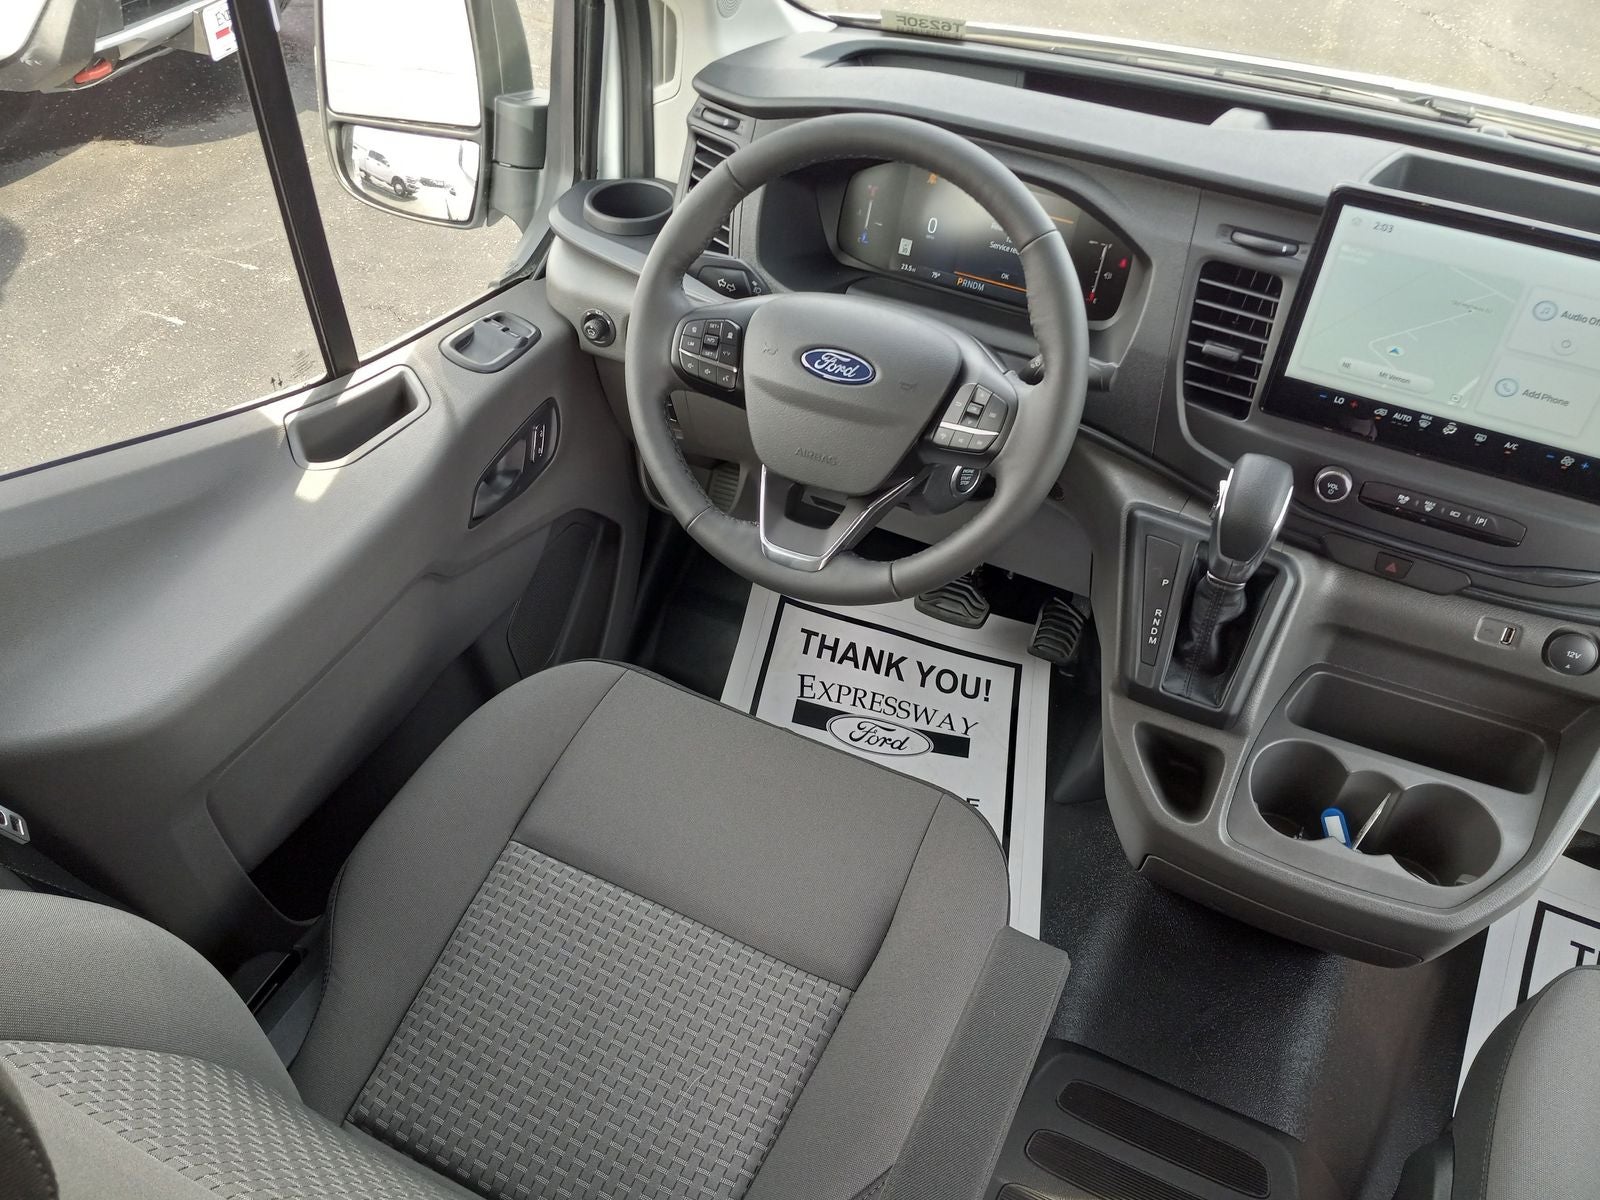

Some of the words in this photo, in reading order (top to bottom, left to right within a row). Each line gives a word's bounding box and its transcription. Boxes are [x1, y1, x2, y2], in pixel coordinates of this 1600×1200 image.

[927, 217, 938, 233] 0
[990, 240, 1010, 252] Service
[1561, 310, 1588, 324] Audio
[814, 352, 860, 377] Ford
[1333, 396, 1345, 405] LO
[1522, 389, 1542, 400] Add
[1541, 392, 1570, 406] Phone
[1393, 412, 1412, 423] AUTO
[1566, 650, 1582, 659] 12V
[800, 627, 909, 682] THANK
[915, 661, 992, 702] YOU!
[797, 673, 979, 736] EXPRESSWAY
[848, 718, 910, 752] Ford
